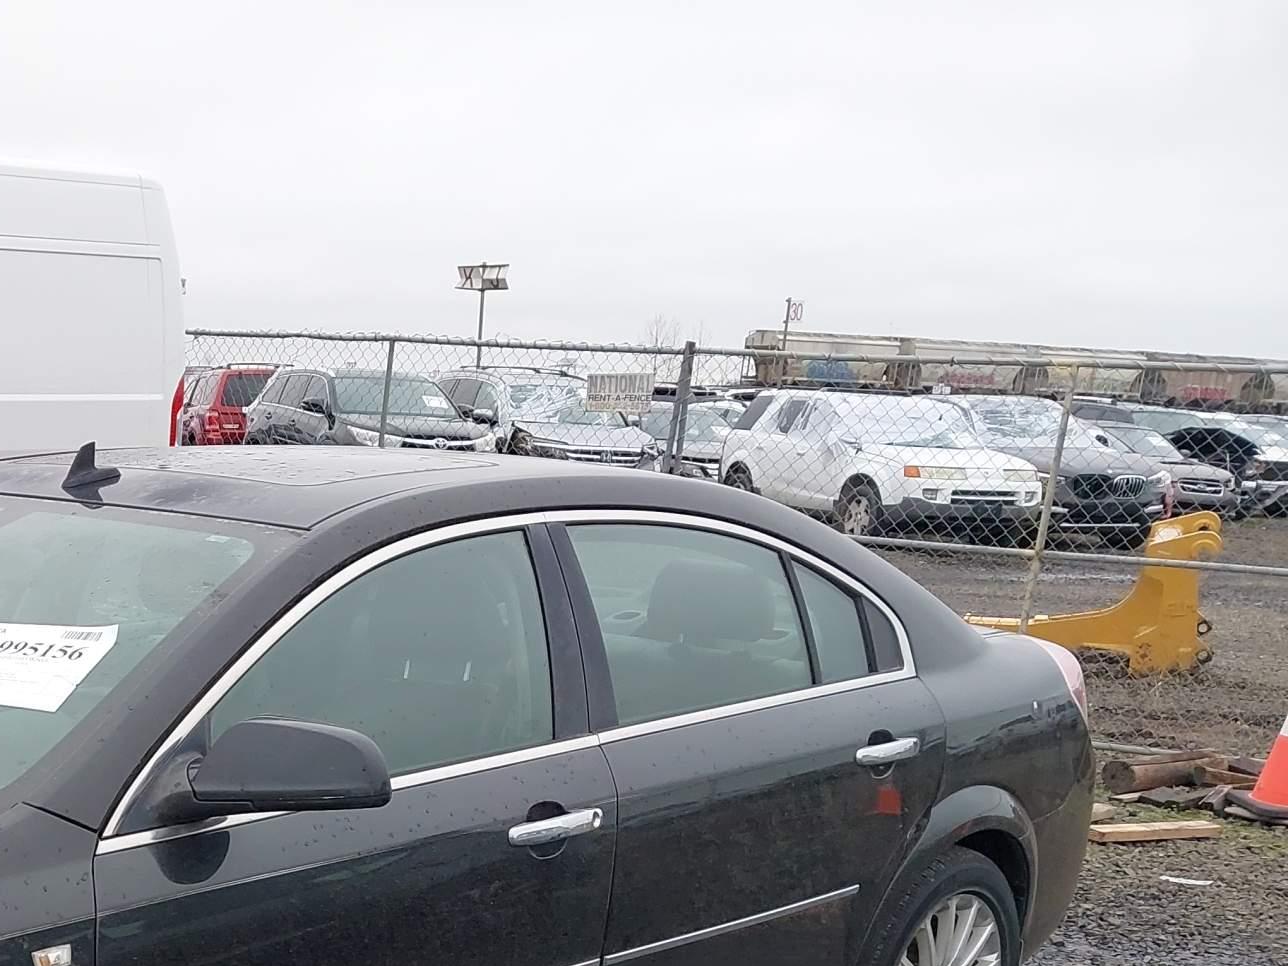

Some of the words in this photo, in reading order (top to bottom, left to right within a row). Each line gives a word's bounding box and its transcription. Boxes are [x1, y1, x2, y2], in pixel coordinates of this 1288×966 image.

[790, 302, 803, 321] 30
[588, 374, 652, 394] NATIONAL
[588, 394, 652, 402] RENT-A-FENCE
